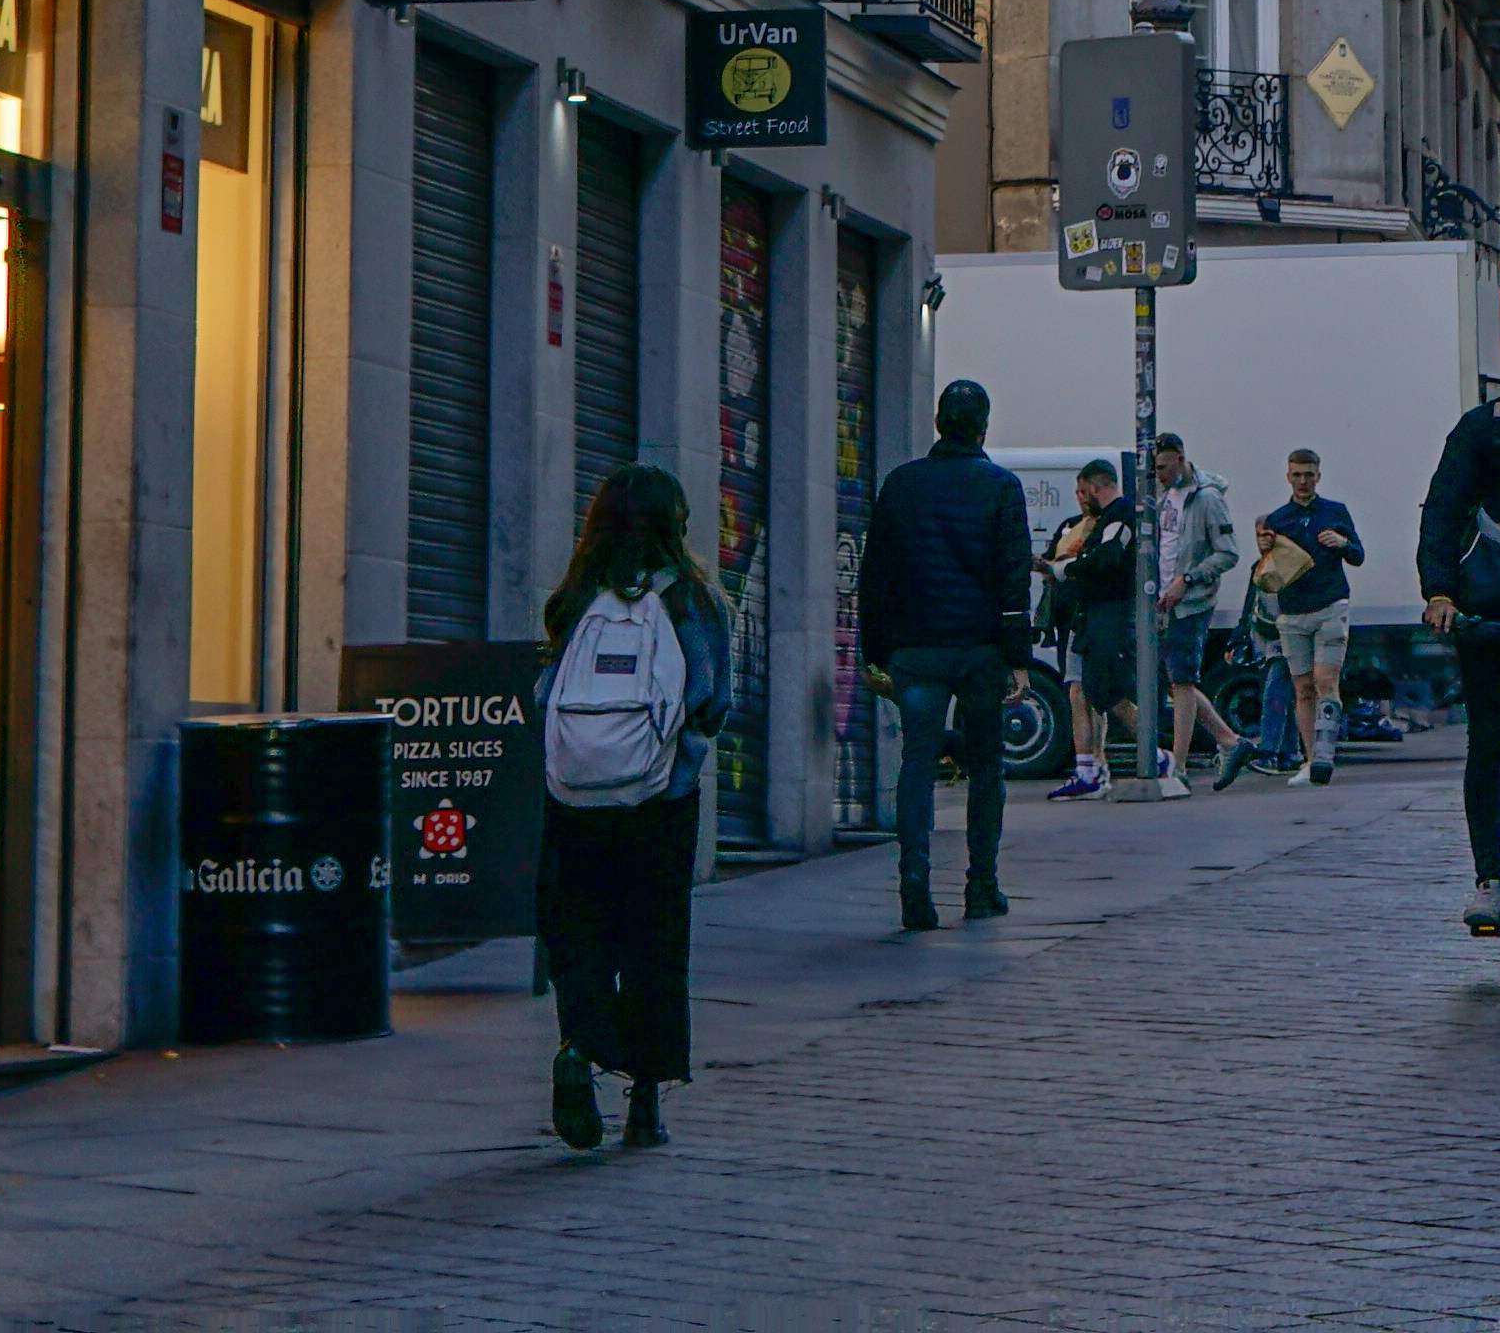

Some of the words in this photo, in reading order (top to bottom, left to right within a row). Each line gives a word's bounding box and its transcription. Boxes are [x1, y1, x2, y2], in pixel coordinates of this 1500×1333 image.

[719, 22, 798, 45] UrVan
[705, 118, 760, 137] Street
[767, 115, 809, 134] Food
[375, 695, 526, 727] TORTUGA
[394, 741, 442, 760] PIZZA
[449, 740, 503, 759] SLICES
[401, 770, 450, 789] SINCE
[455, 769, 493, 787] 1987
[198, 858, 304, 893] Galicia
